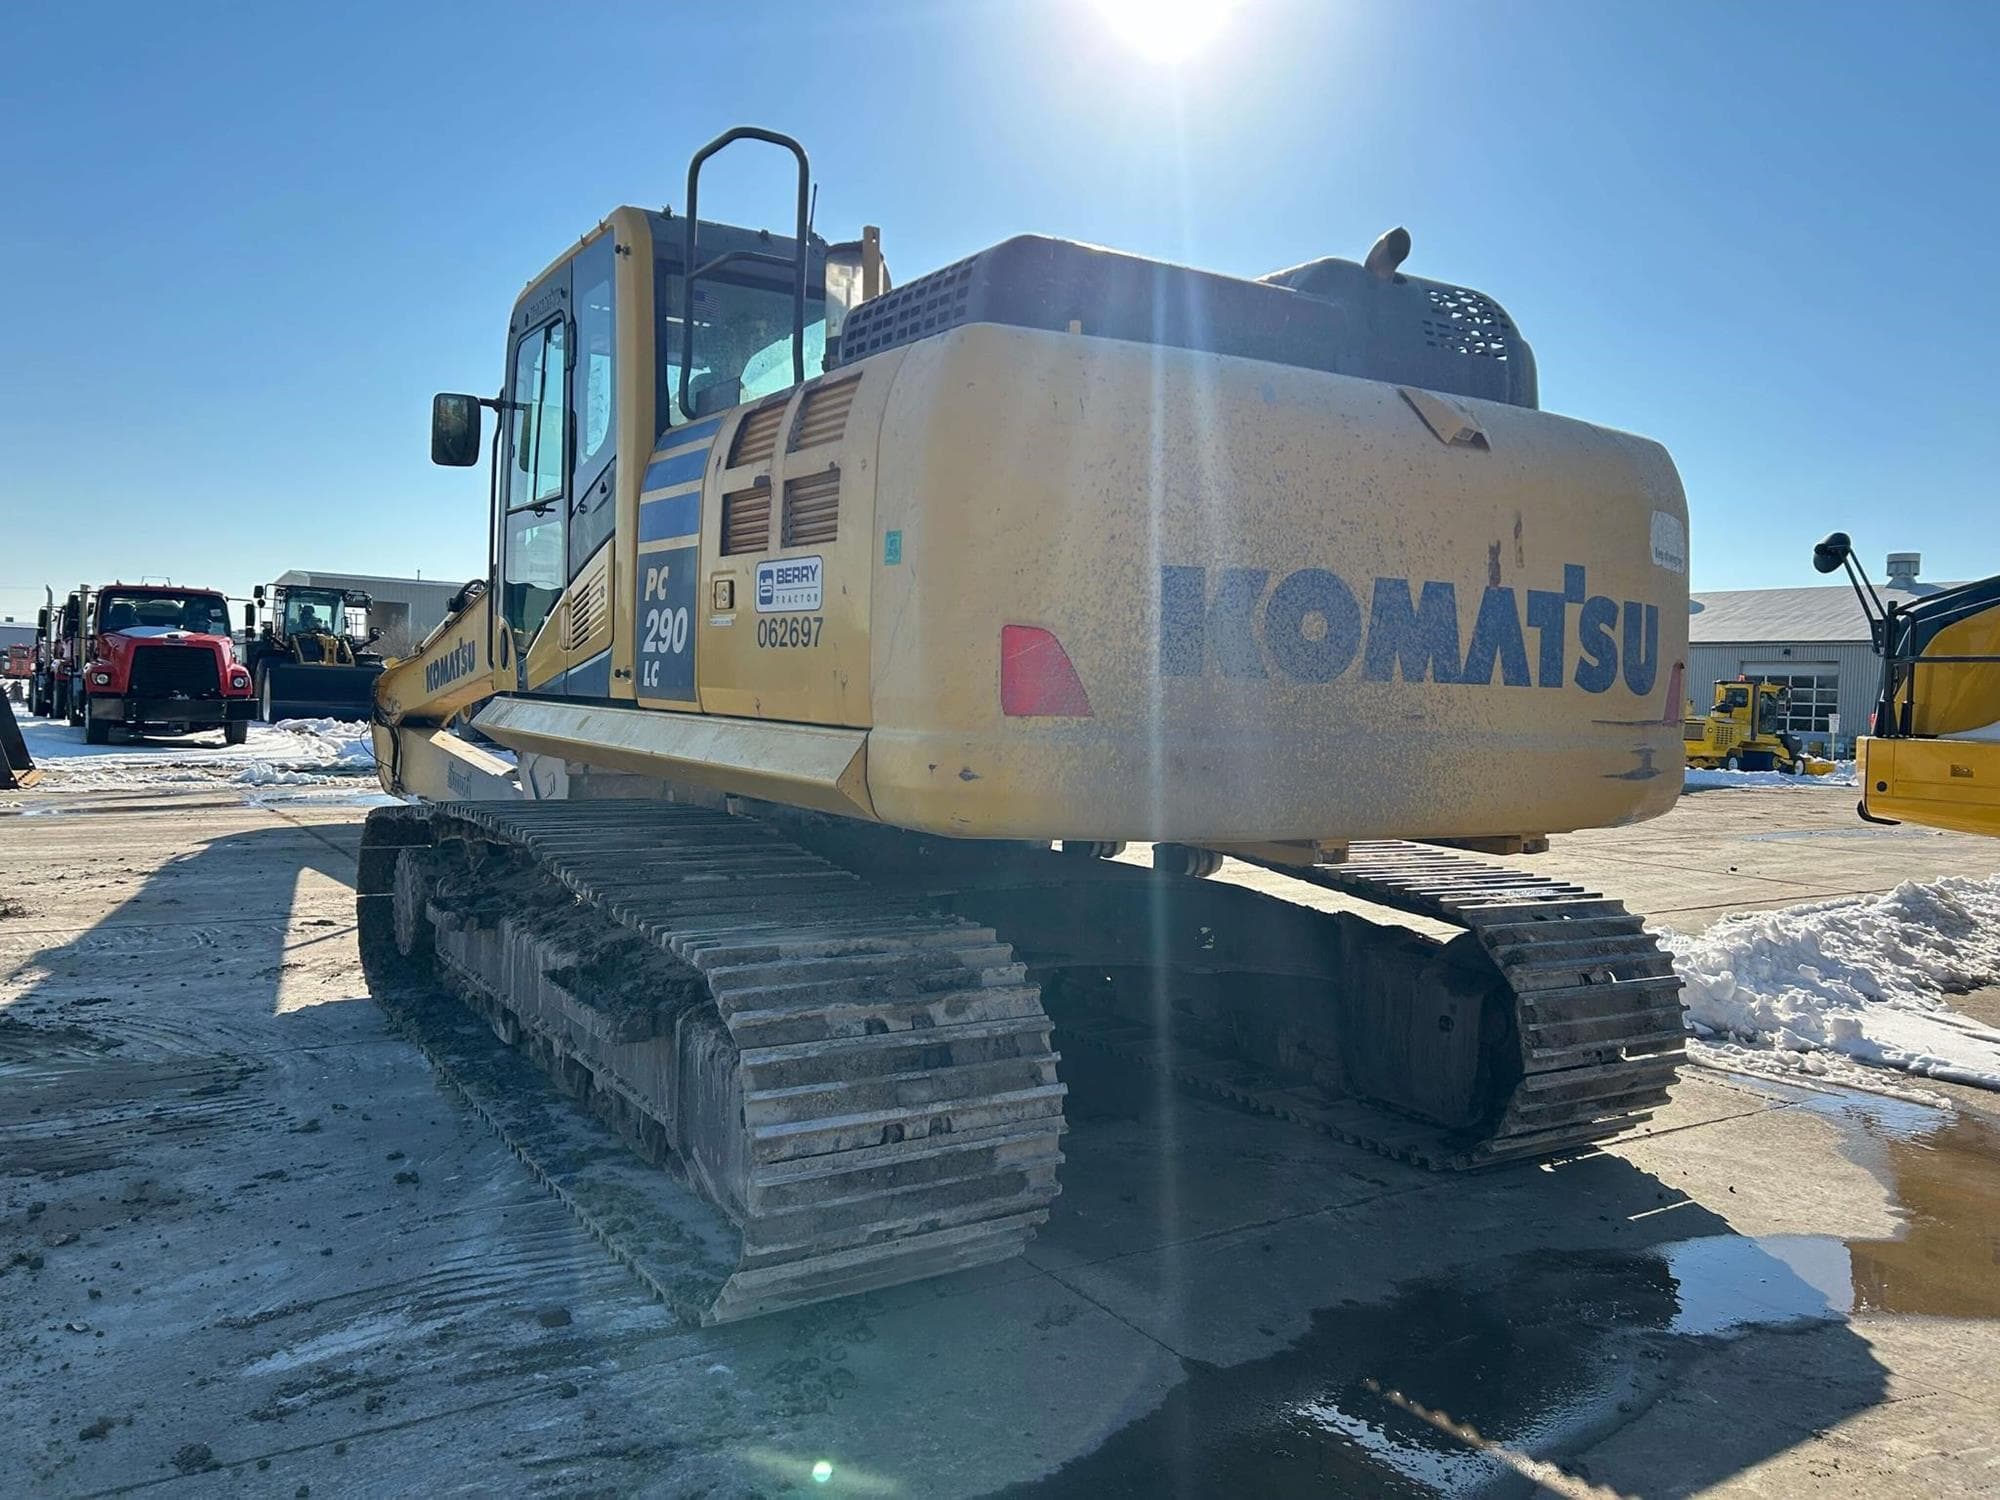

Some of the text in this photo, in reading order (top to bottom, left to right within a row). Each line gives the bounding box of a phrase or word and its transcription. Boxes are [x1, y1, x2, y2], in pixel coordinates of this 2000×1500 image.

[644, 565, 670, 601] PC
[776, 564, 819, 585] BERRY
[642, 606, 689, 654] 290
[757, 616, 824, 648] 062697
[1160, 564, 1659, 696] KOMATSU
[426, 637, 476, 693] KOMATSU
[643, 660, 660, 688] LC
